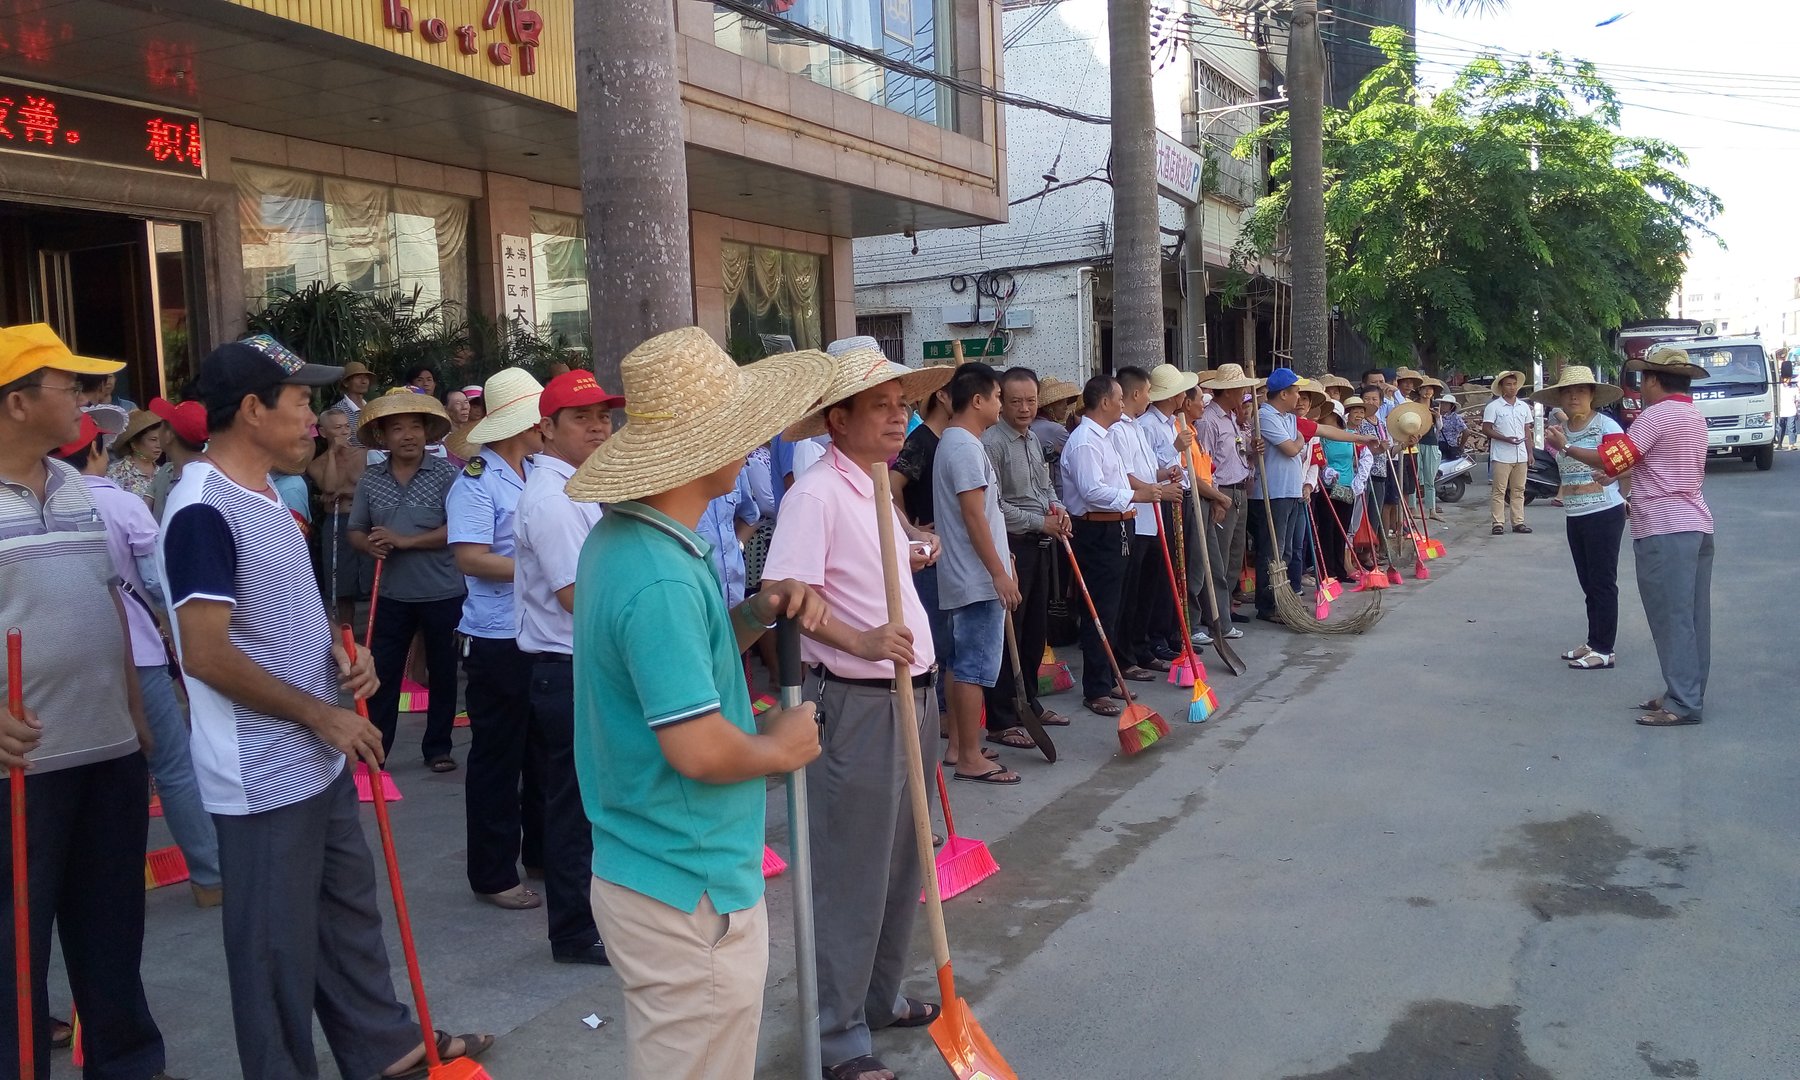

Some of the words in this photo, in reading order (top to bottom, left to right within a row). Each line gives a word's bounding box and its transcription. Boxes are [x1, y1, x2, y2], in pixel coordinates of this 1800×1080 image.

[384, 0, 536, 76] hotel
[1155, 139, 1193, 191] 大酒店欢迎您
[1191, 162, 1200, 193] P
[505, 246, 517, 297] 美兰区
[517, 248, 529, 298] 海口市
[512, 304, 529, 326] 大
